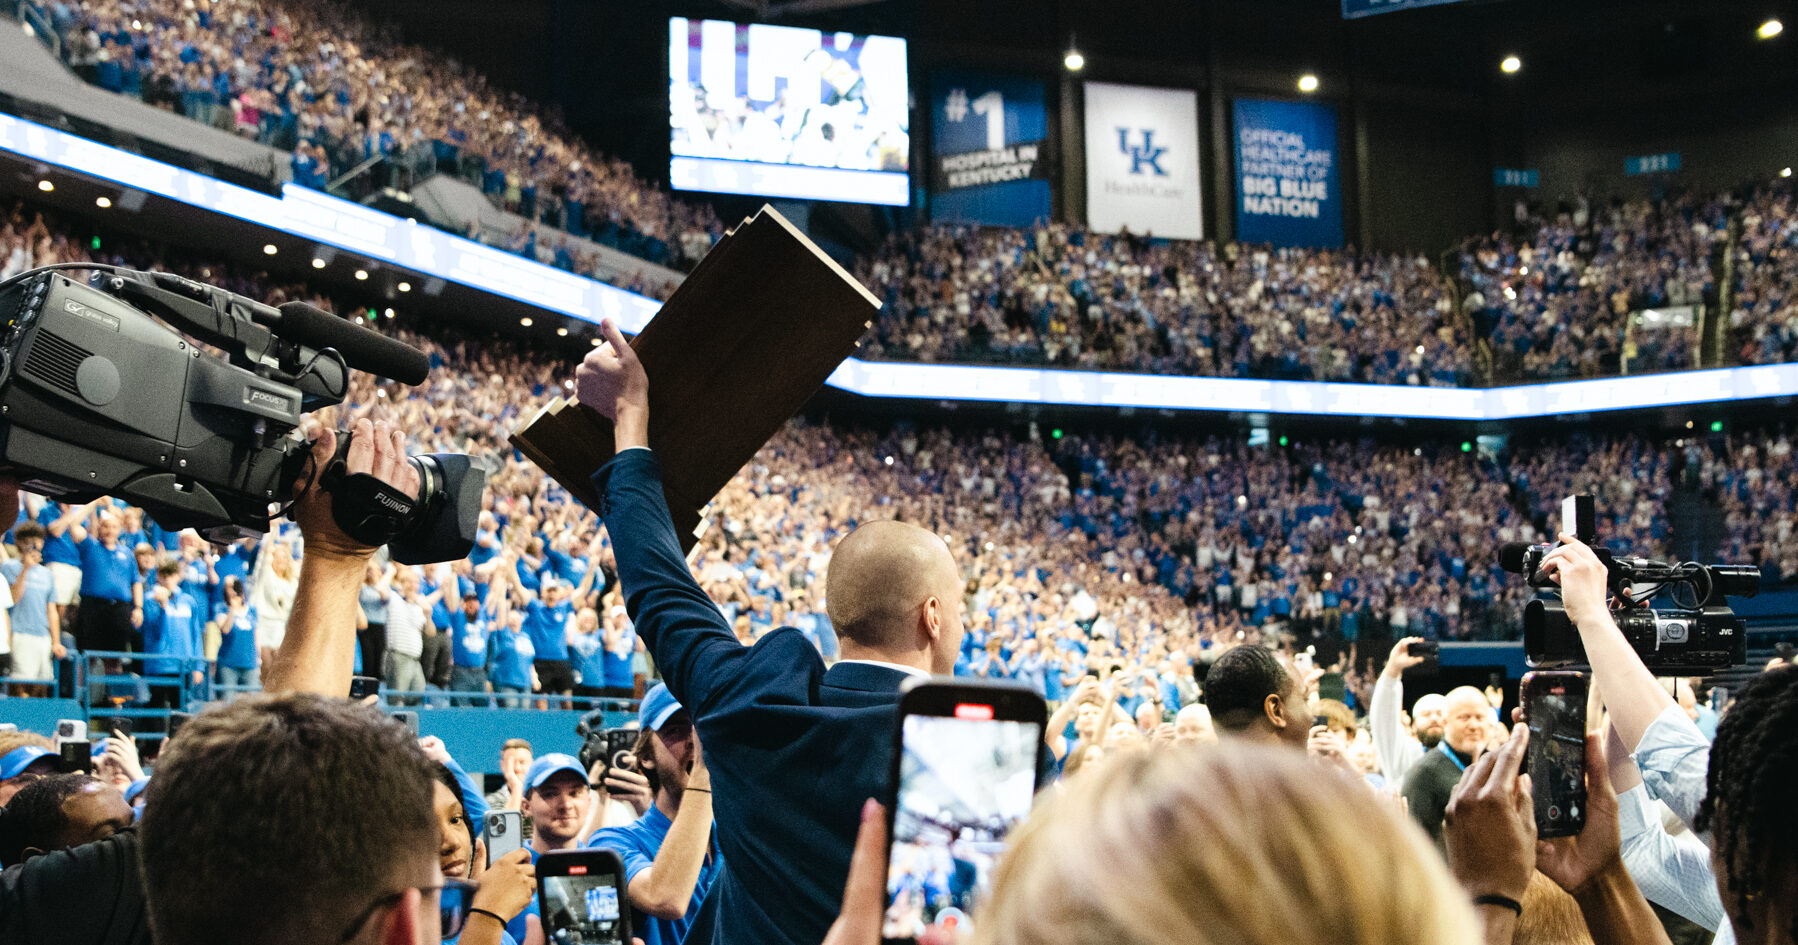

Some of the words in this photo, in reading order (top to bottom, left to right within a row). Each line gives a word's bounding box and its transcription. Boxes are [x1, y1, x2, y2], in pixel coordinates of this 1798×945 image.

[944, 88, 1005, 150] #1
[1114, 127, 1169, 177] UK
[1241, 128, 1305, 153] OFFICIAL
[942, 148, 1017, 172] HOSPITAL
[1018, 145, 1038, 162] IN
[1242, 145, 1331, 167] HEALTHCARE
[948, 162, 1033, 188] KENTUCKY
[1242, 160, 1305, 180] PARTNER
[1307, 165, 1328, 183] OF
[1243, 175, 1277, 197] BIG
[1280, 179, 1328, 201] BLUE
[1243, 195, 1320, 218] NATION
[374, 491, 411, 515] FUJINON
[1718, 628, 1733, 636] JVC
